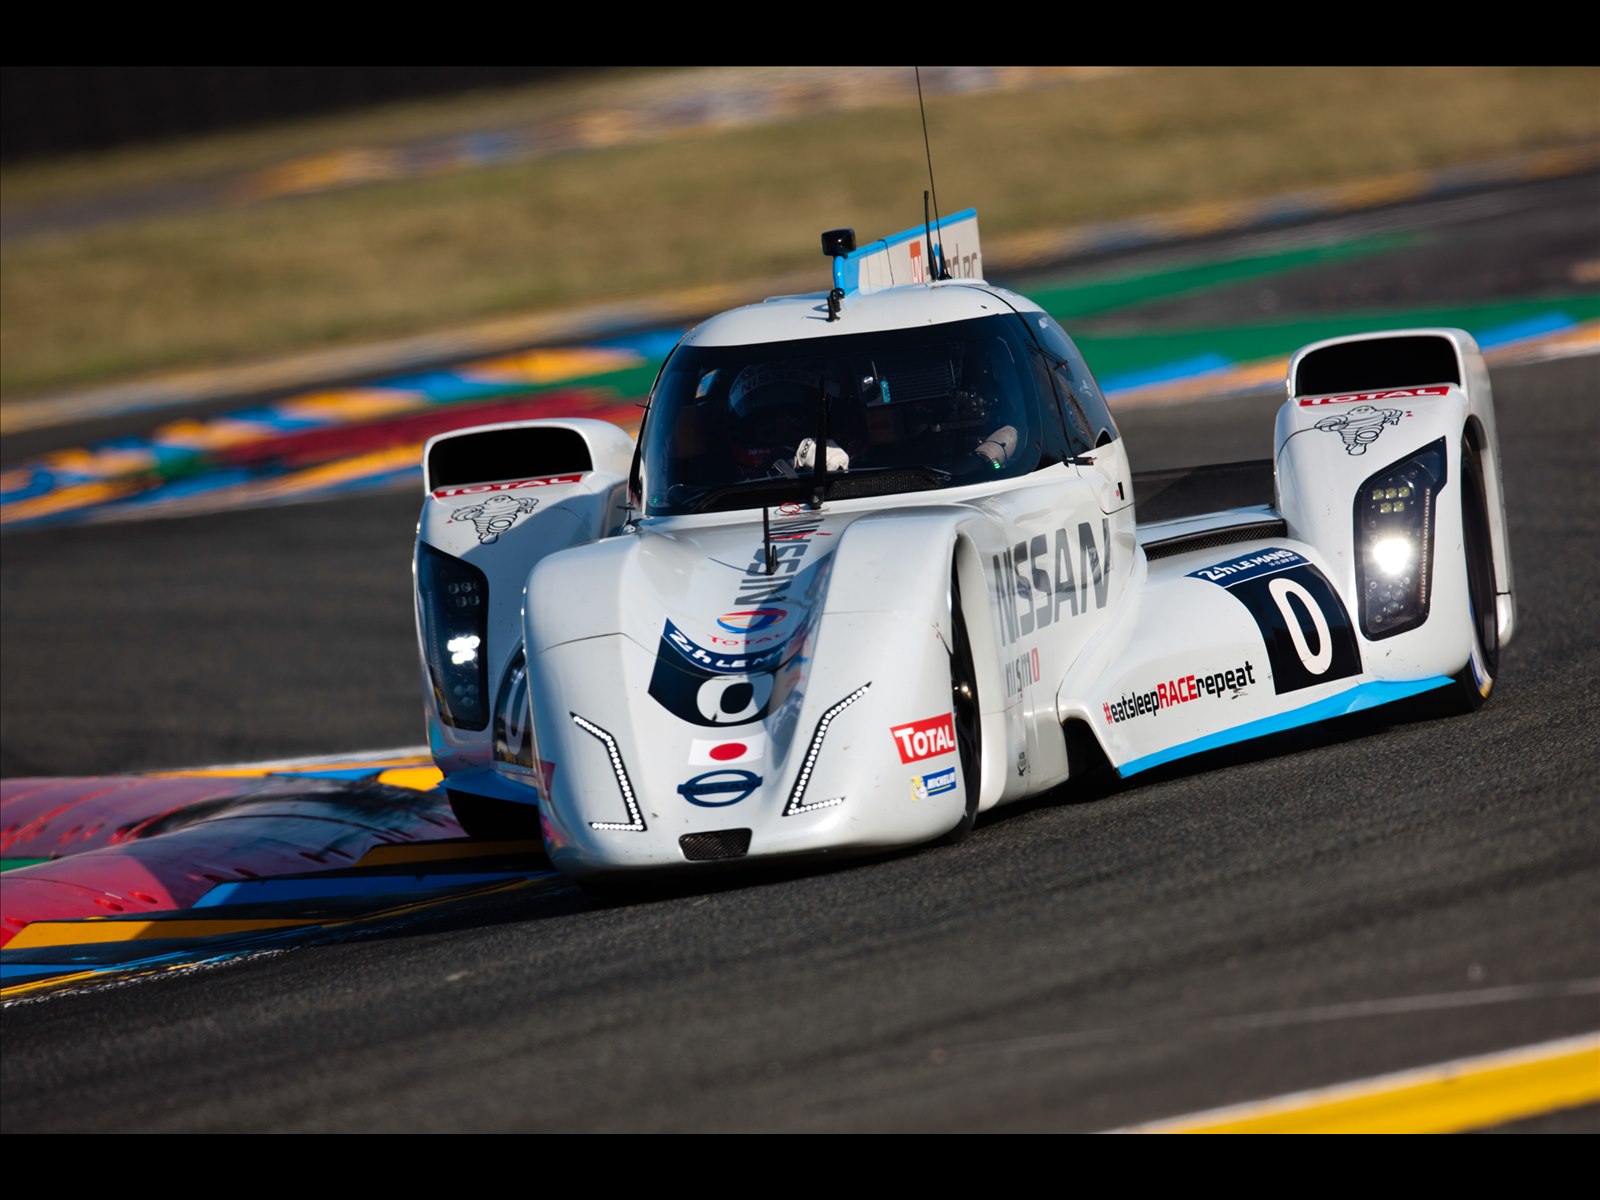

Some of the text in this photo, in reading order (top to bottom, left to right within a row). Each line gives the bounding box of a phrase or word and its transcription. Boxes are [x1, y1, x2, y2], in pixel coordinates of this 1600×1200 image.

[1309, 388, 1441, 405] TOTAL
[439, 477, 573, 495] TOTAL
[1232, 560, 1256, 571] LE
[1250, 550, 1294, 565] MANS
[993, 518, 1111, 647] NISSAN
[1268, 577, 1333, 675] 0
[707, 633, 786, 647] TOTAL
[716, 658, 746, 668] LE
[1006, 648, 1040, 698] nismo
[697, 673, 776, 723] 0
[1103, 660, 1256, 725] #eatsleepRACErepeat
[894, 724, 956, 758] TOTAL
[685, 780, 755, 794] NISSAN
[926, 771, 956, 790] MICHELIN
